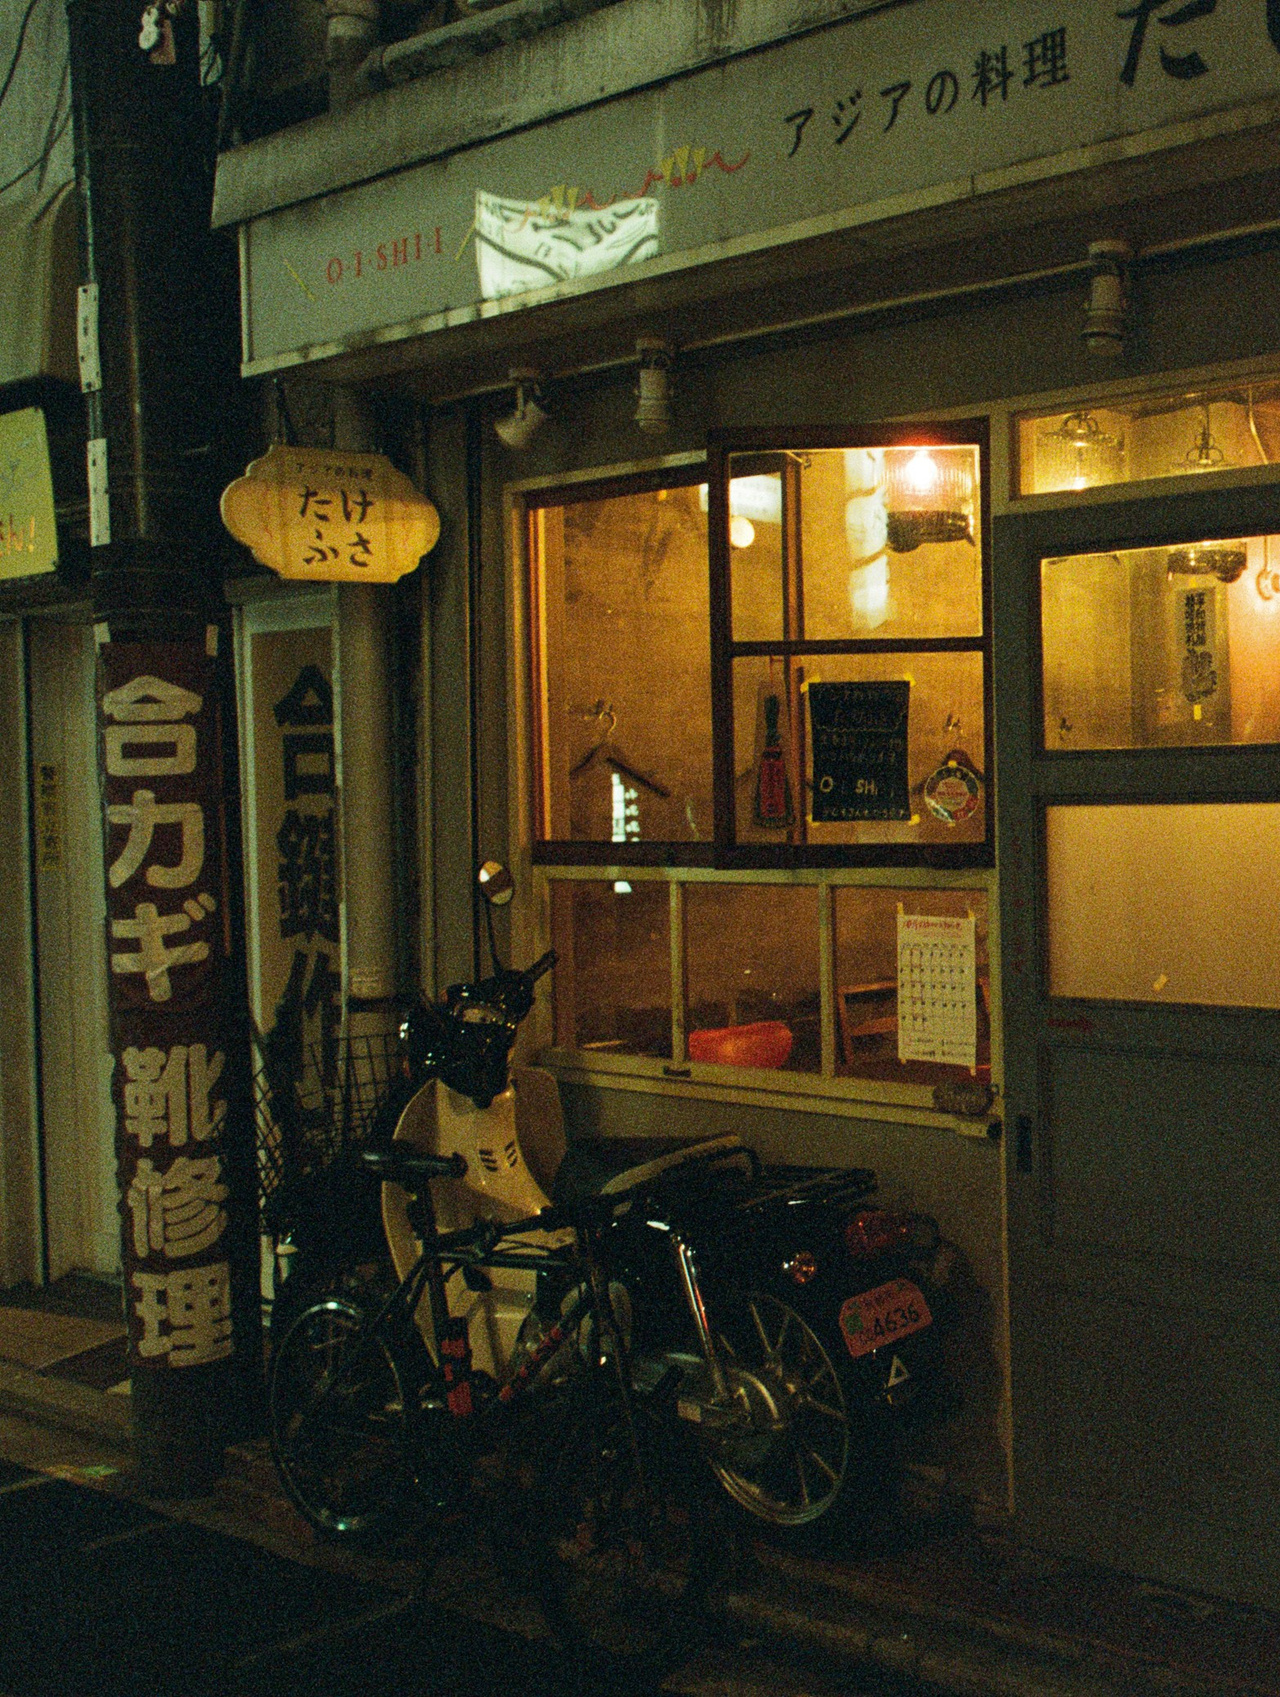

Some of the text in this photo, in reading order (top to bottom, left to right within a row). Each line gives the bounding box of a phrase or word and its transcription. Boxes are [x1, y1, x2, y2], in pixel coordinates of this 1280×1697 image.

[783, 25, 1072, 159] アジアの料理
[874, 1303, 920, 1337] 4636
